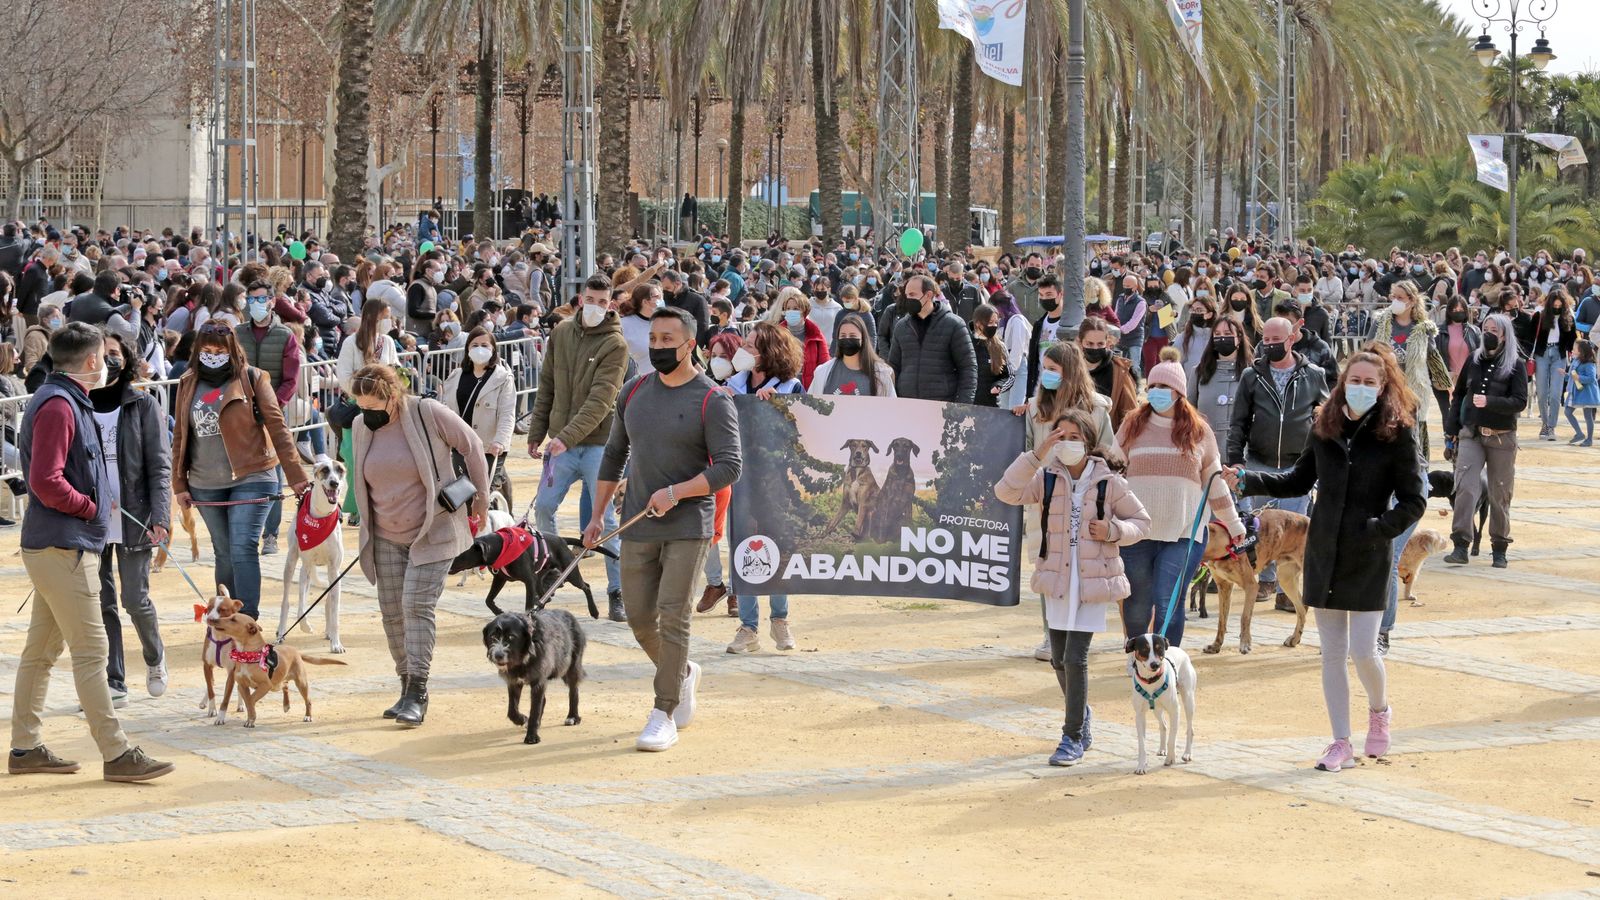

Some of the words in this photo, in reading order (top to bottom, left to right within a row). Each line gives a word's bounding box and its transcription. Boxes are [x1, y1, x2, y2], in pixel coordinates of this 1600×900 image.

[939, 515, 1009, 532] PROTECTORA
[901, 526, 954, 554] NO
[962, 531, 1009, 562] ME
[782, 553, 1010, 592] ABANDONES
